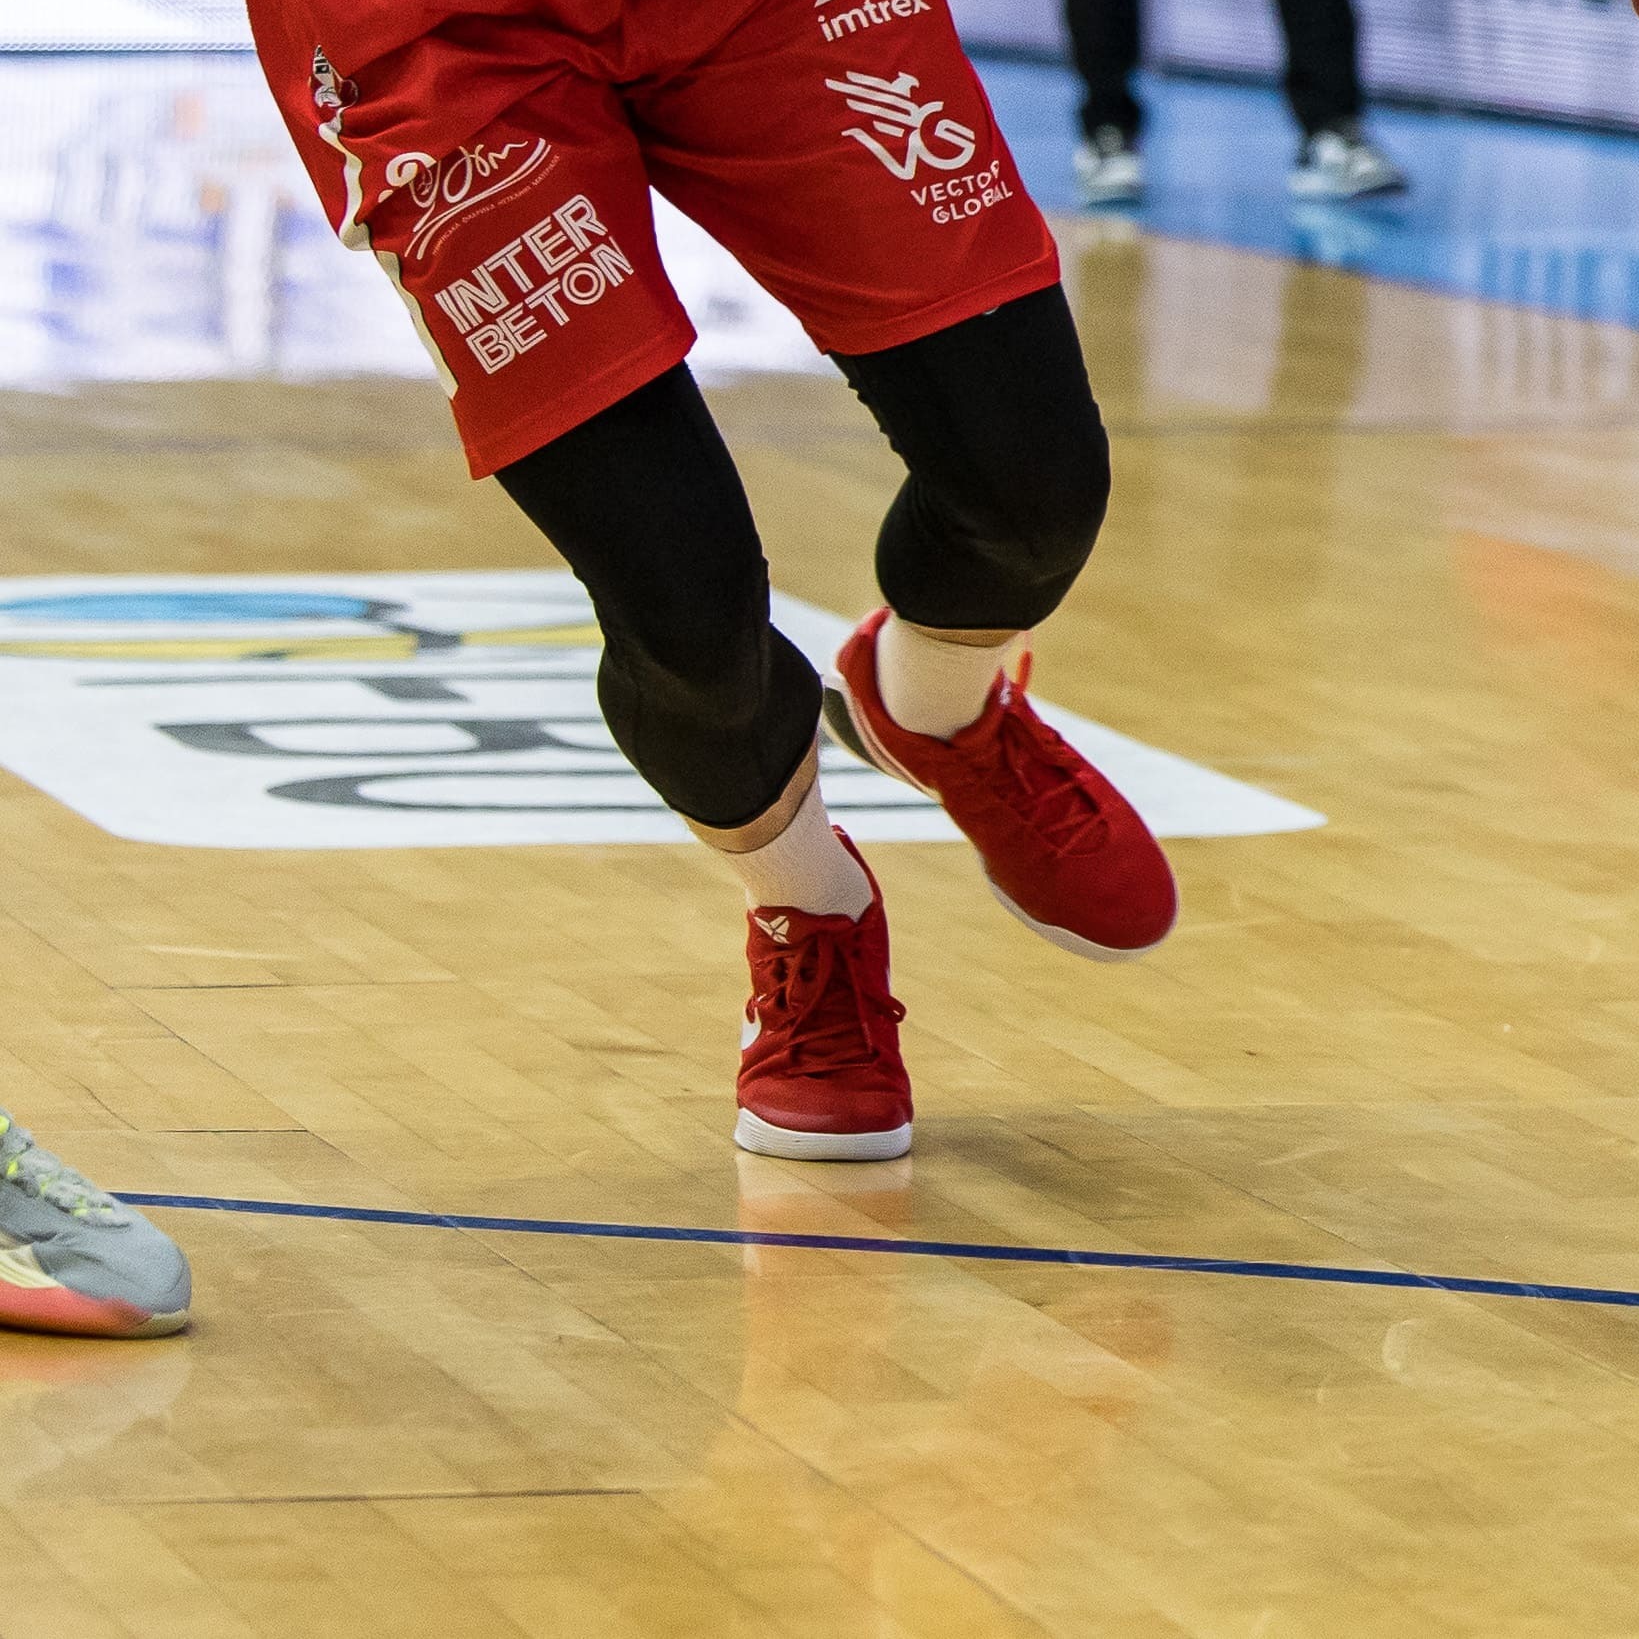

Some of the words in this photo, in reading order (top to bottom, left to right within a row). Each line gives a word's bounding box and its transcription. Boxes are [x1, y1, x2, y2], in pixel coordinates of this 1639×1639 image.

[911, 160, 1001, 206] VECTOR
[932, 180, 1014, 224] GLOBAL
[434, 194, 609, 335] INTER
[465, 235, 635, 375] BETON
